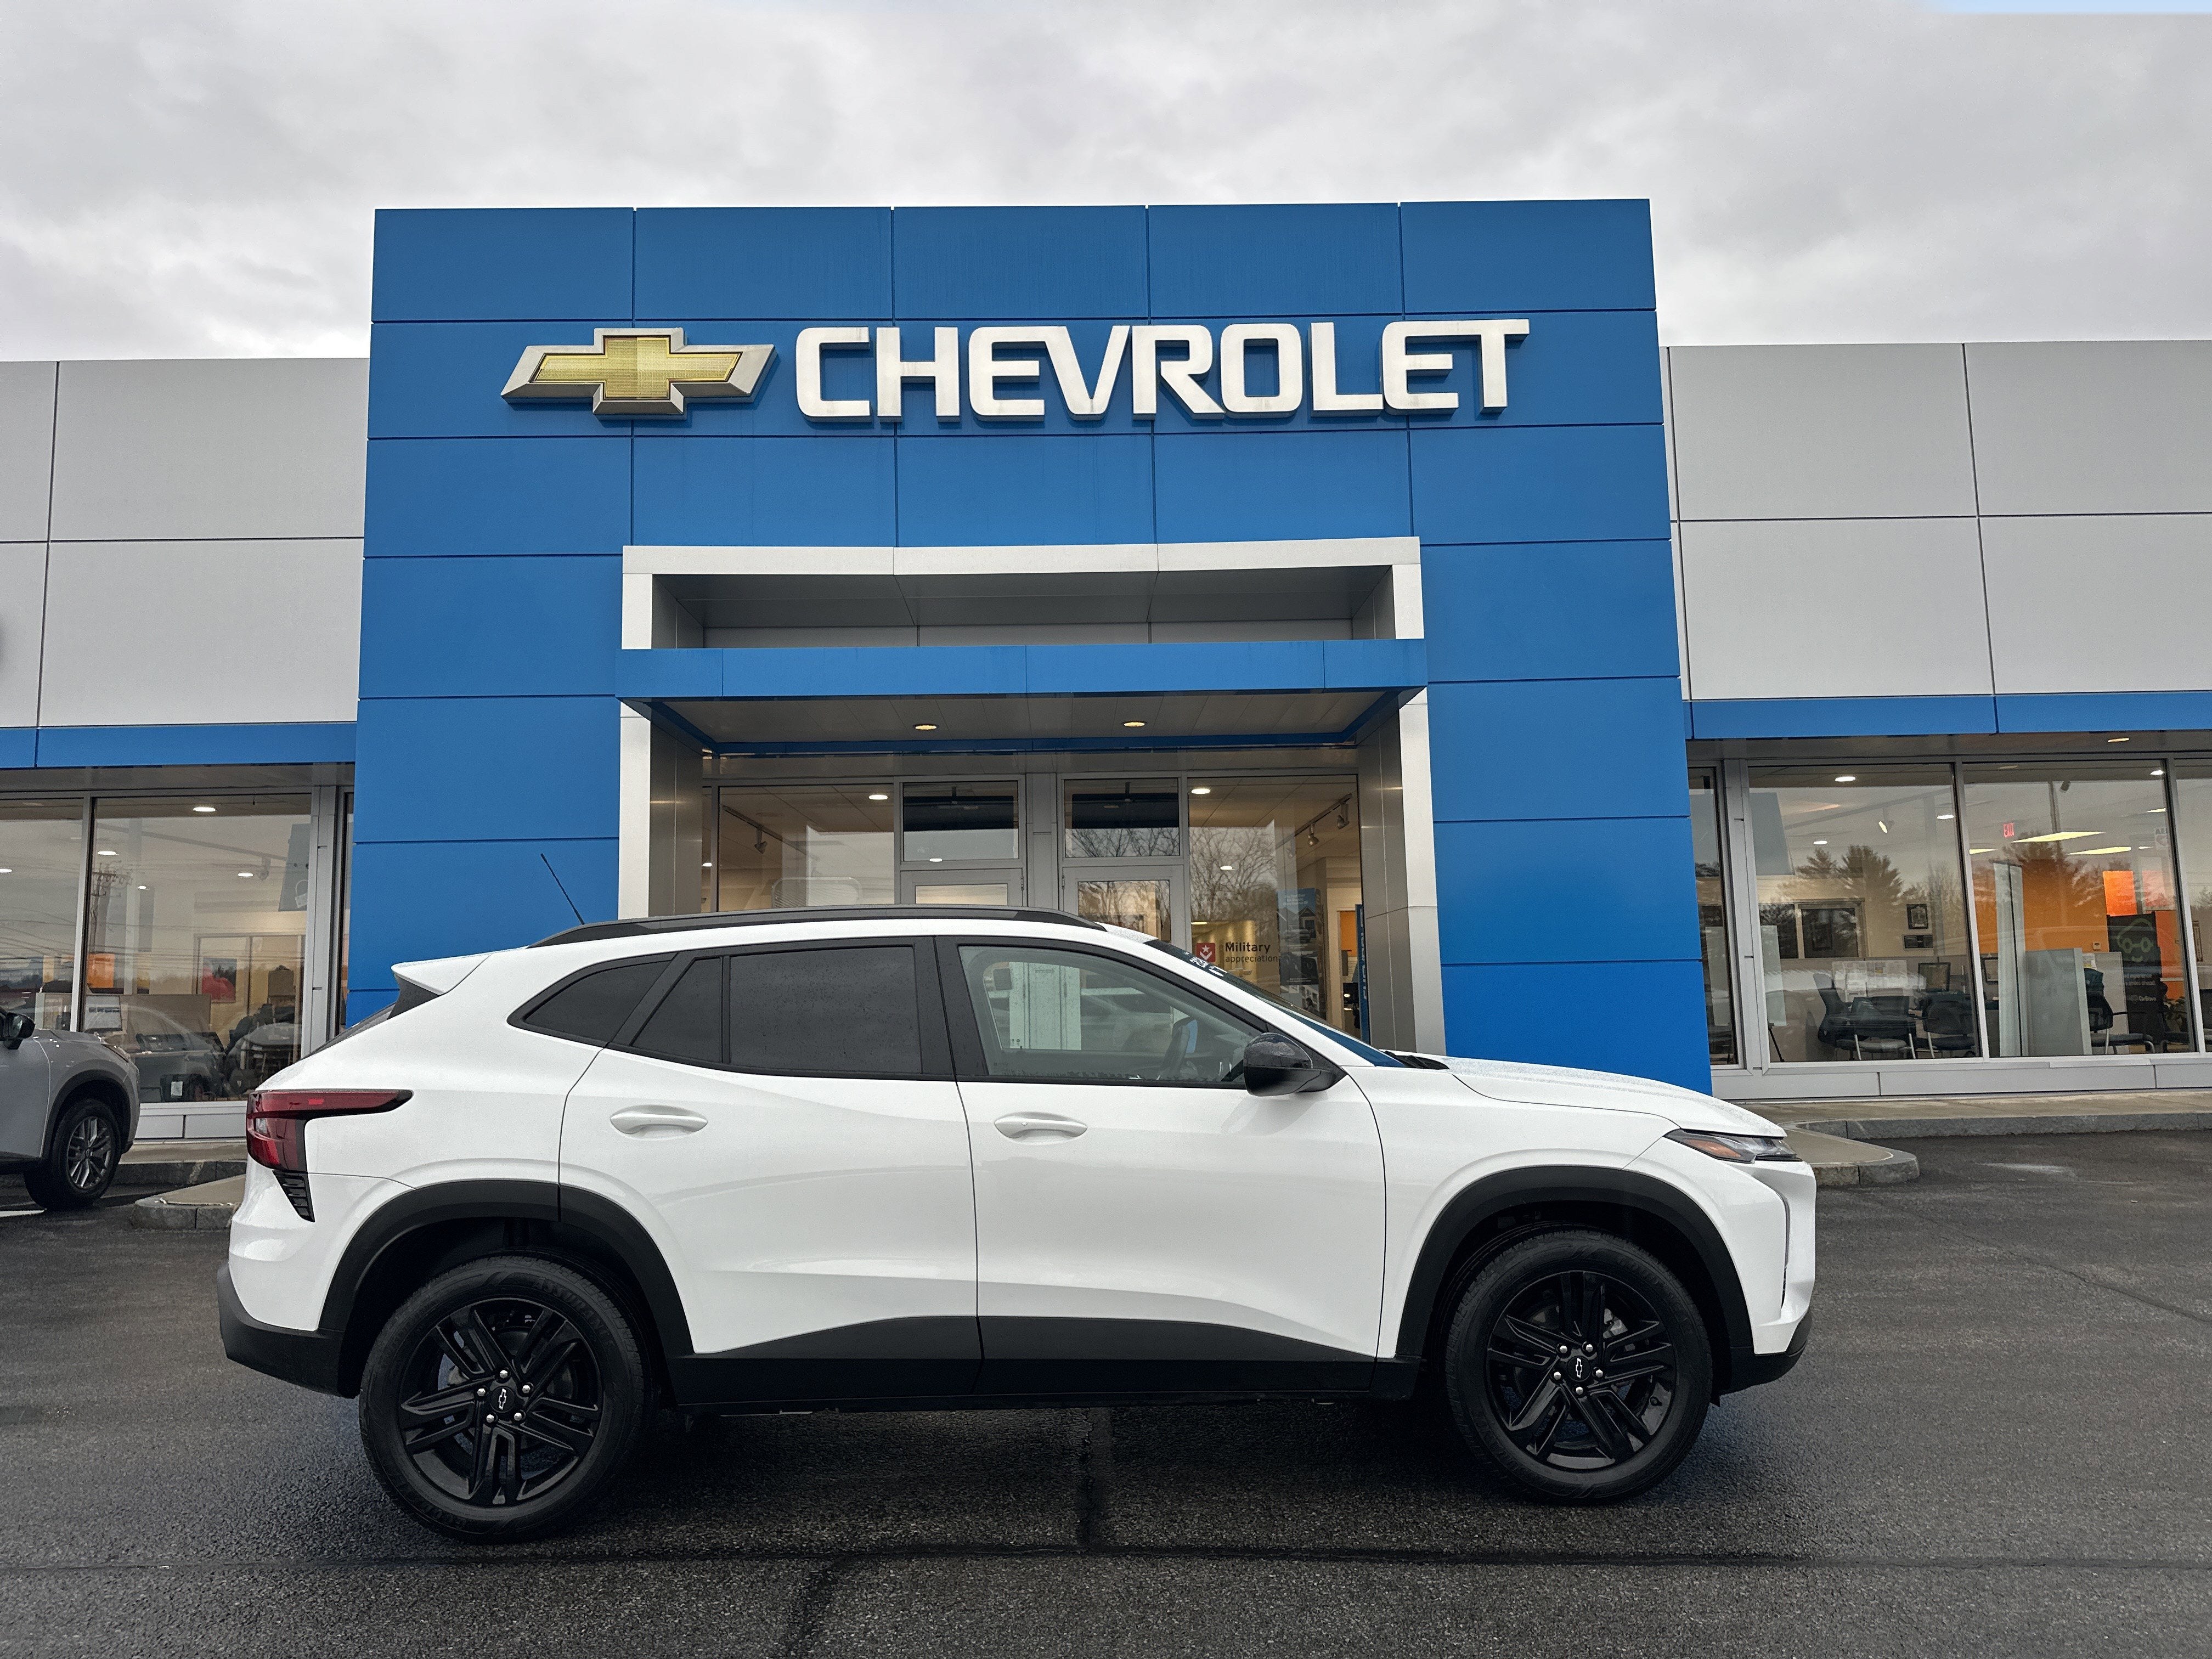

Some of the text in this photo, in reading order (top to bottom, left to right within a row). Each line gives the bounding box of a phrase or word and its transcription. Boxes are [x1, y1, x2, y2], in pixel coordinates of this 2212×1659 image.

[796, 319, 1530, 421] CHEVROLET
[2004, 823, 2014, 837] EXIT
[1225, 942, 1271, 953] Military
[1225, 955, 1278, 963] appreciation
